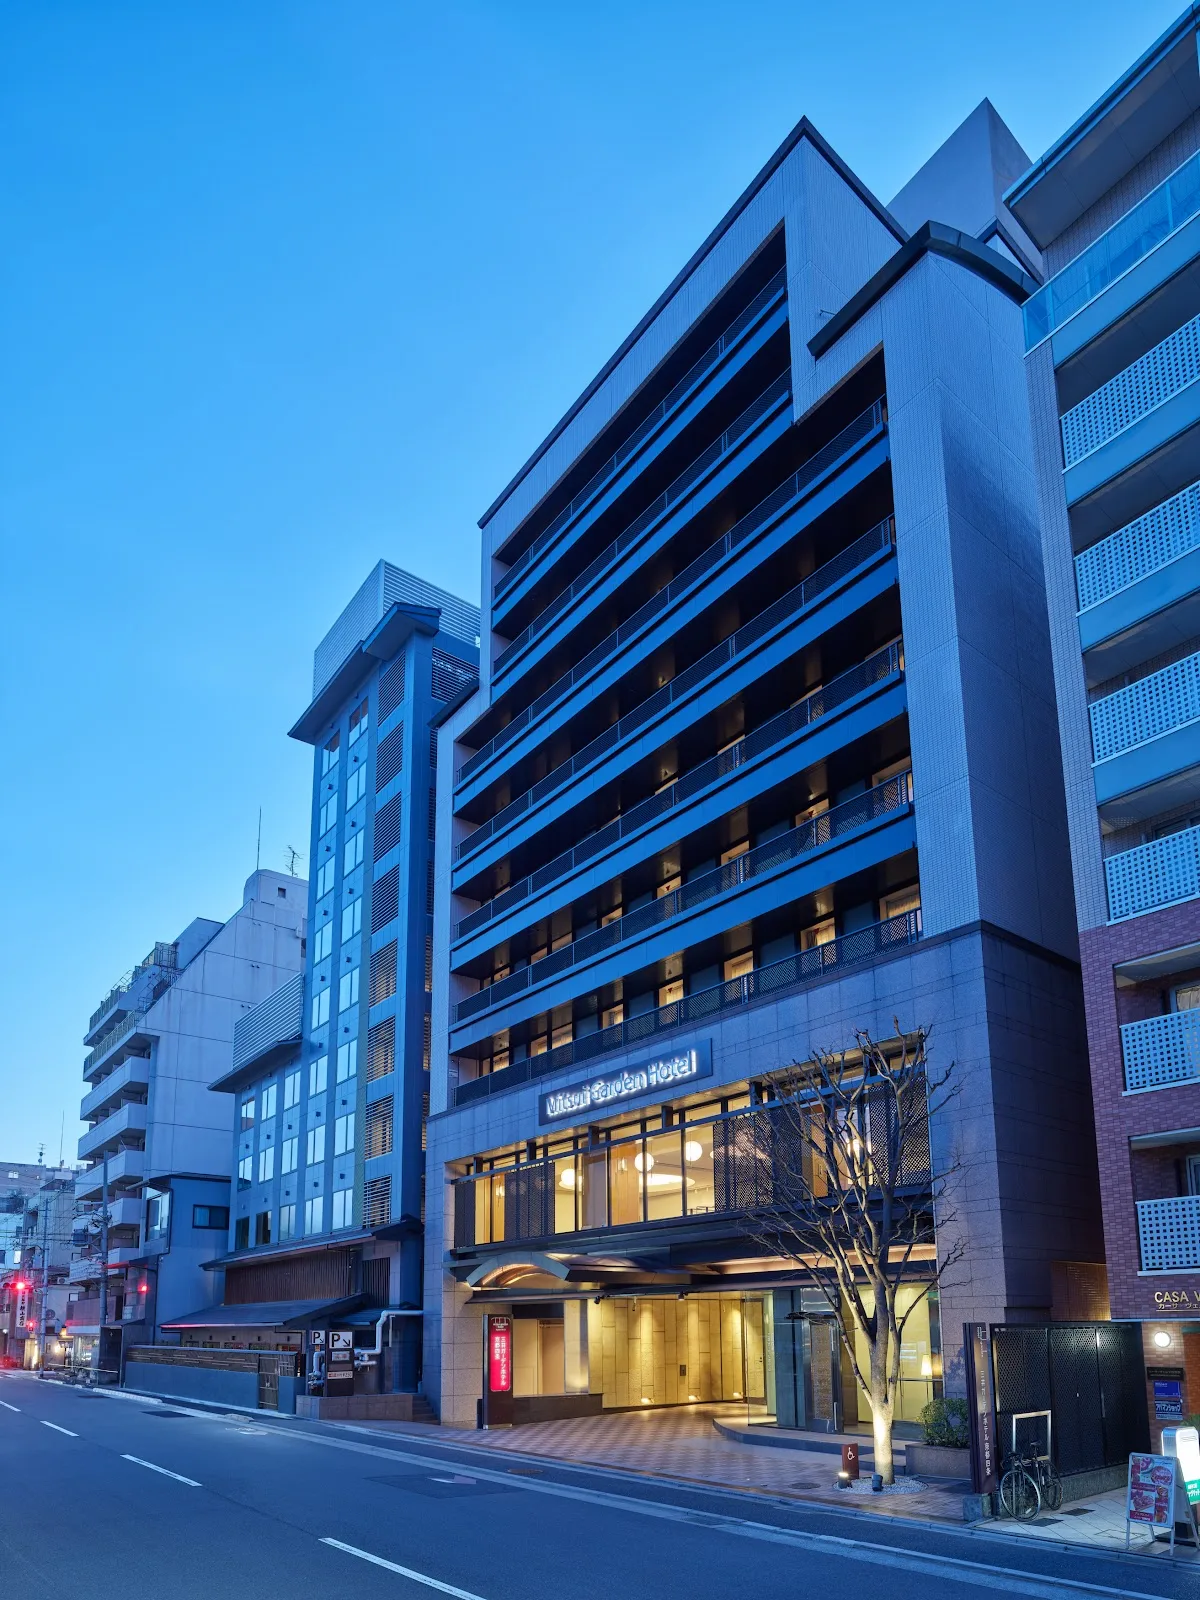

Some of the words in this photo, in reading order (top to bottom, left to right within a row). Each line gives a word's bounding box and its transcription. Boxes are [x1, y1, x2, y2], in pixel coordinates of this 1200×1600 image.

[545, 1085, 591, 1117] Mitsui
[590, 1071, 648, 1104] Garden
[647, 1049, 697, 1086] Hotel
[1154, 1291, 1189, 1303] CASA
[313, 1331, 321, 1344] P
[331, 1333, 341, 1348] P
